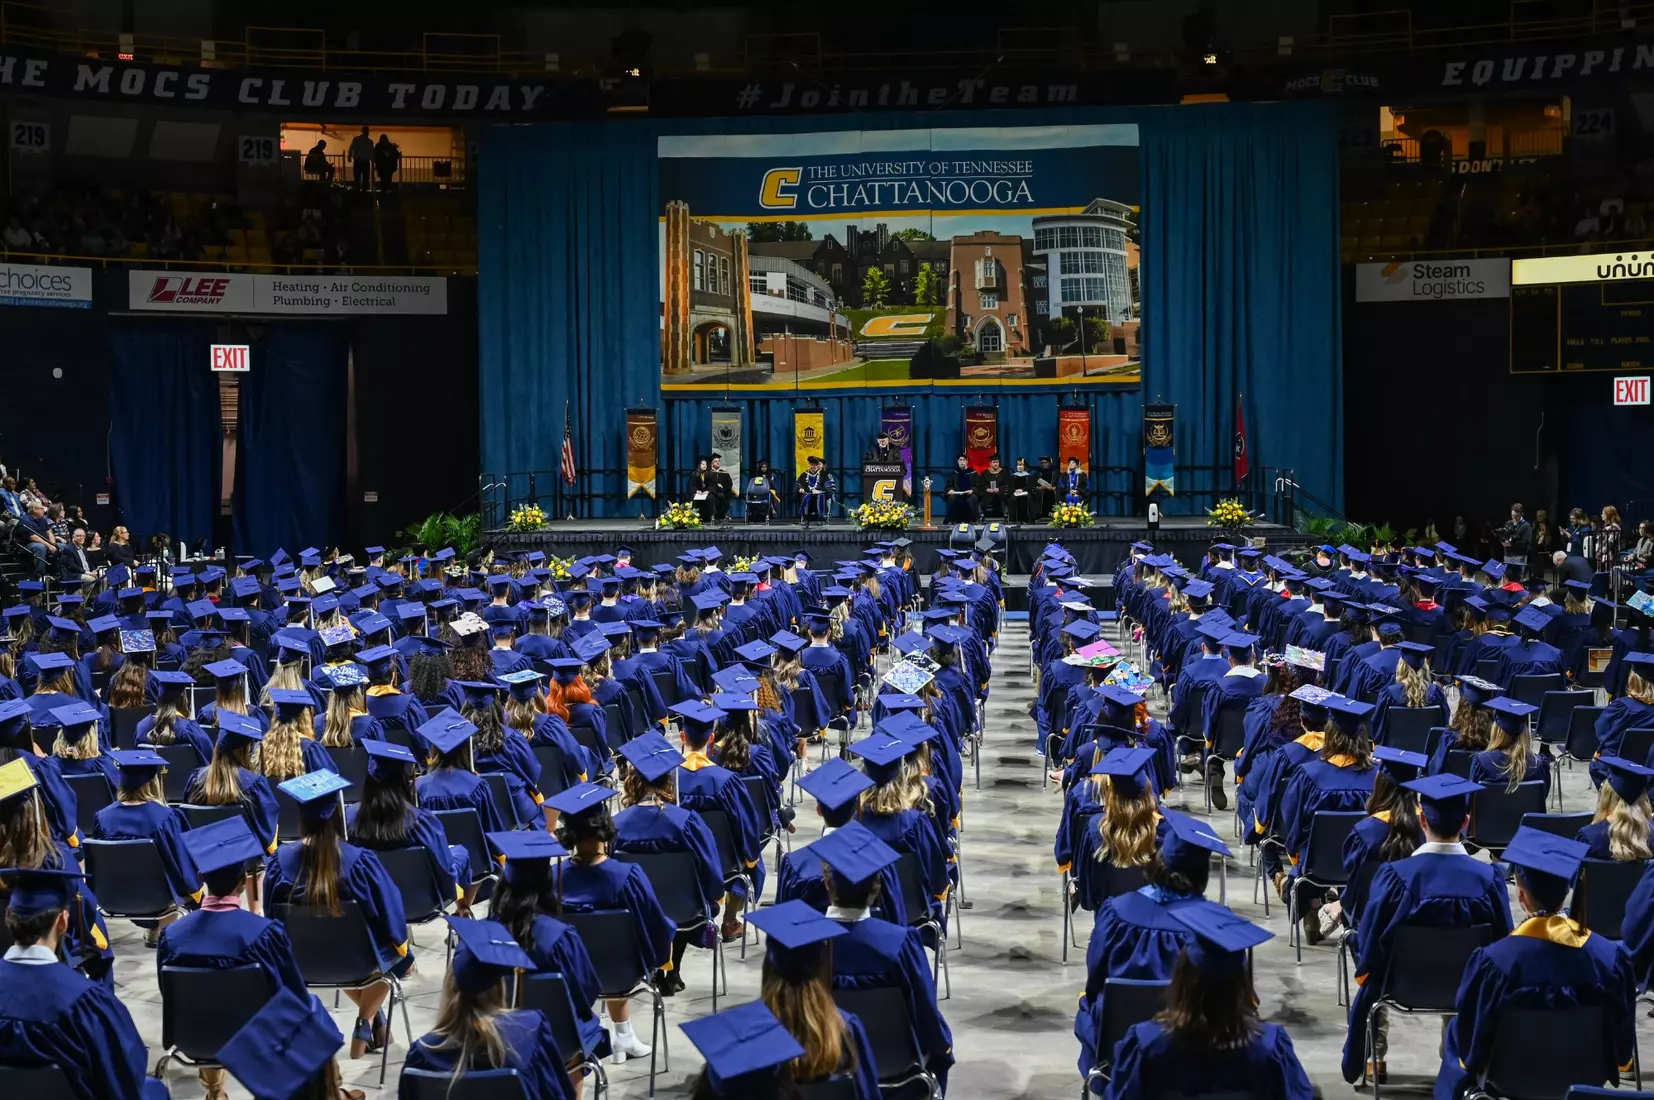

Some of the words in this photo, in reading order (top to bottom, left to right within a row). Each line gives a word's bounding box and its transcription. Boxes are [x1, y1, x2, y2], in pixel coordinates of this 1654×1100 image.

[1440, 44, 1654, 87] EQUIPPIN
[0, 55, 49, 87] HE
[73, 64, 211, 101] MOCS
[238, 77, 363, 108] CLUB
[387, 83, 545, 111] TODAY
[735, 78, 1078, 109] #JointheTeam
[1284, 76, 1321, 92] MOCS
[1345, 74, 1381, 88] CLUB
[1575, 112, 1612, 136] 224
[15, 124, 46, 147] 219
[242, 139, 274, 160] 219
[807, 165, 838, 179] THE
[840, 160, 926, 178] UNIVERSITY
[928, 160, 949, 175] OF
[952, 160, 1034, 175] TENNESSEE
[807, 179, 1035, 209] CHATTANOOGA
[0, 267, 72, 292] choices
[1412, 263, 1471, 279] Steam
[180, 277, 231, 297] LEE
[272, 281, 320, 294] Heating
[330, 282, 348, 292] Air
[351, 282, 431, 295] Conditioning
[1412, 279, 1485, 298] Logistics
[175, 296, 223, 305] COMPANY
[272, 296, 331, 308] Plumbing
[341, 297, 396, 306] Electrical
[213, 347, 248, 369] EXIT
[1616, 379, 1648, 403] EXIT
